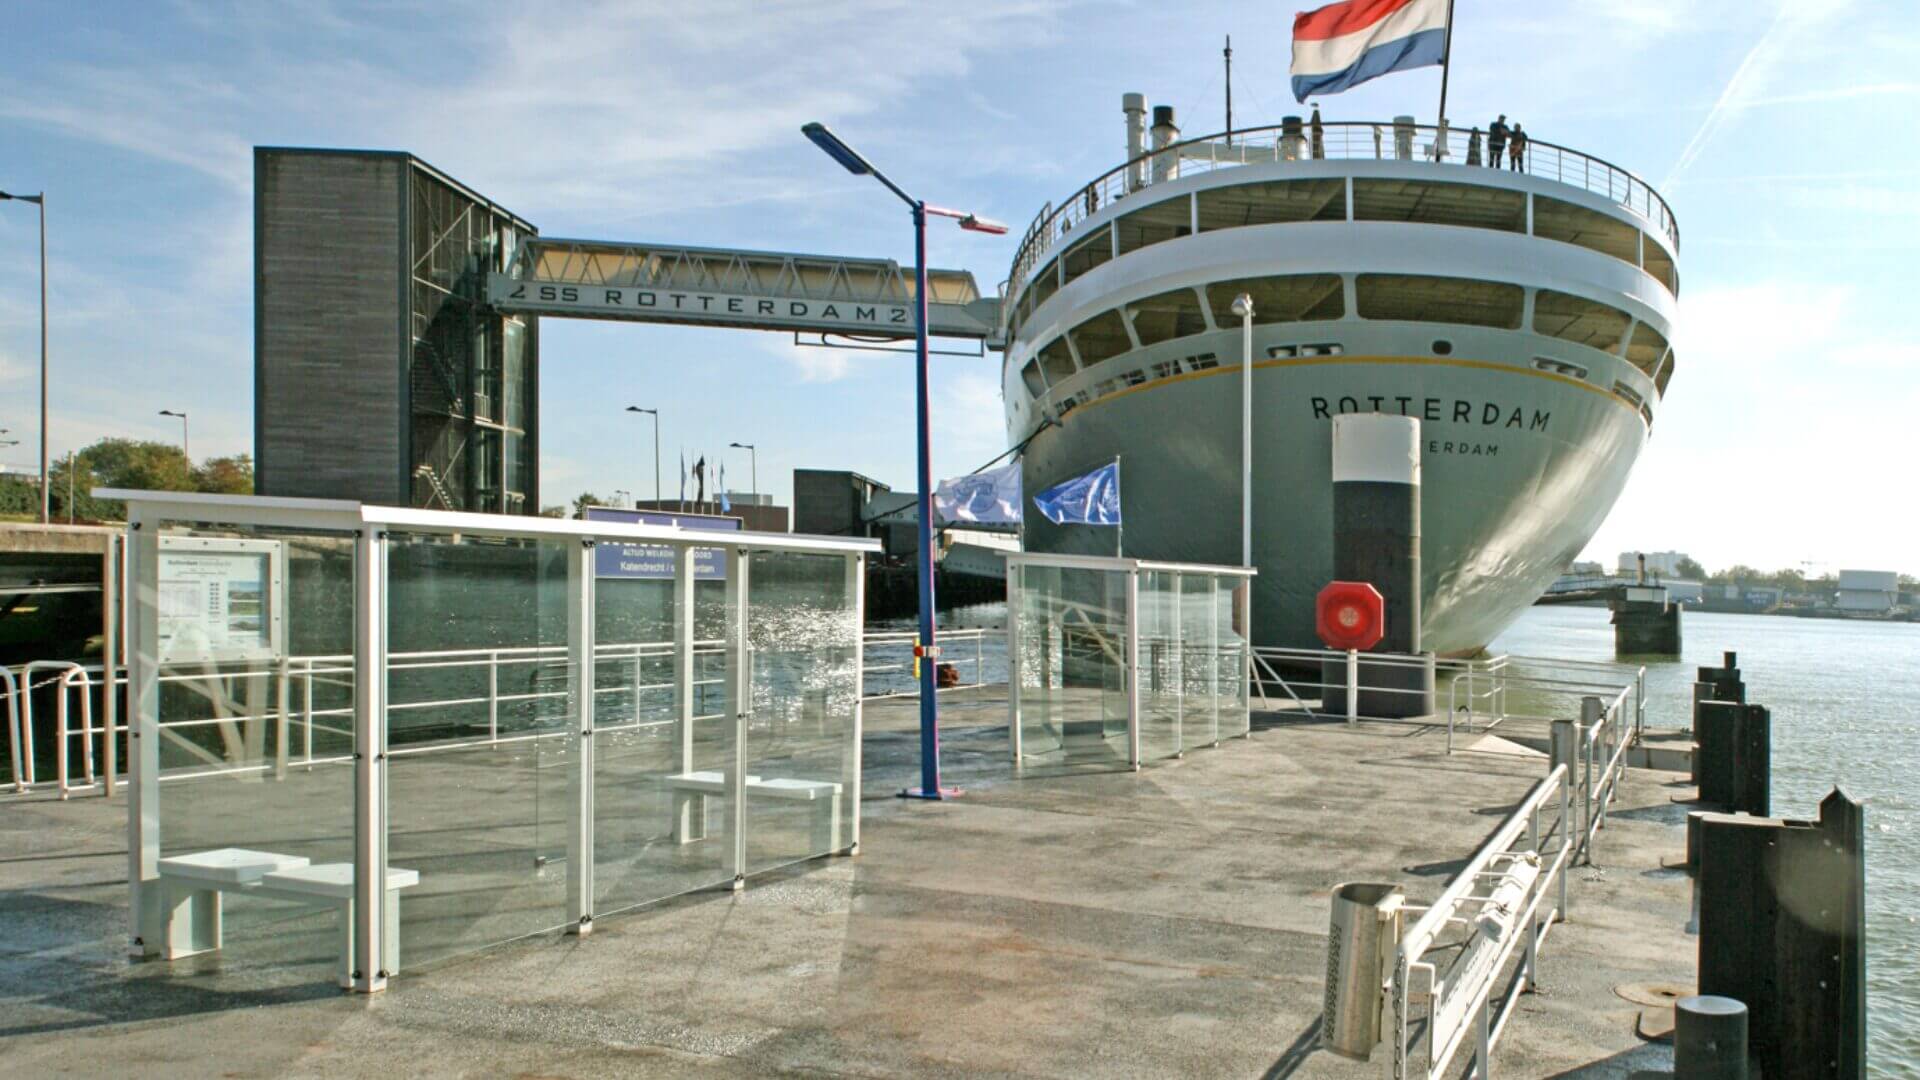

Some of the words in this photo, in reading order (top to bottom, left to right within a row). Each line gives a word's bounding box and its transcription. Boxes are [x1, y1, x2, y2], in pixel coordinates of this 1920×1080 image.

[540, 286, 578, 302] SS
[1311, 396, 1552, 433] ROTTERDAM
[1425, 440, 1499, 457] ERDAM
